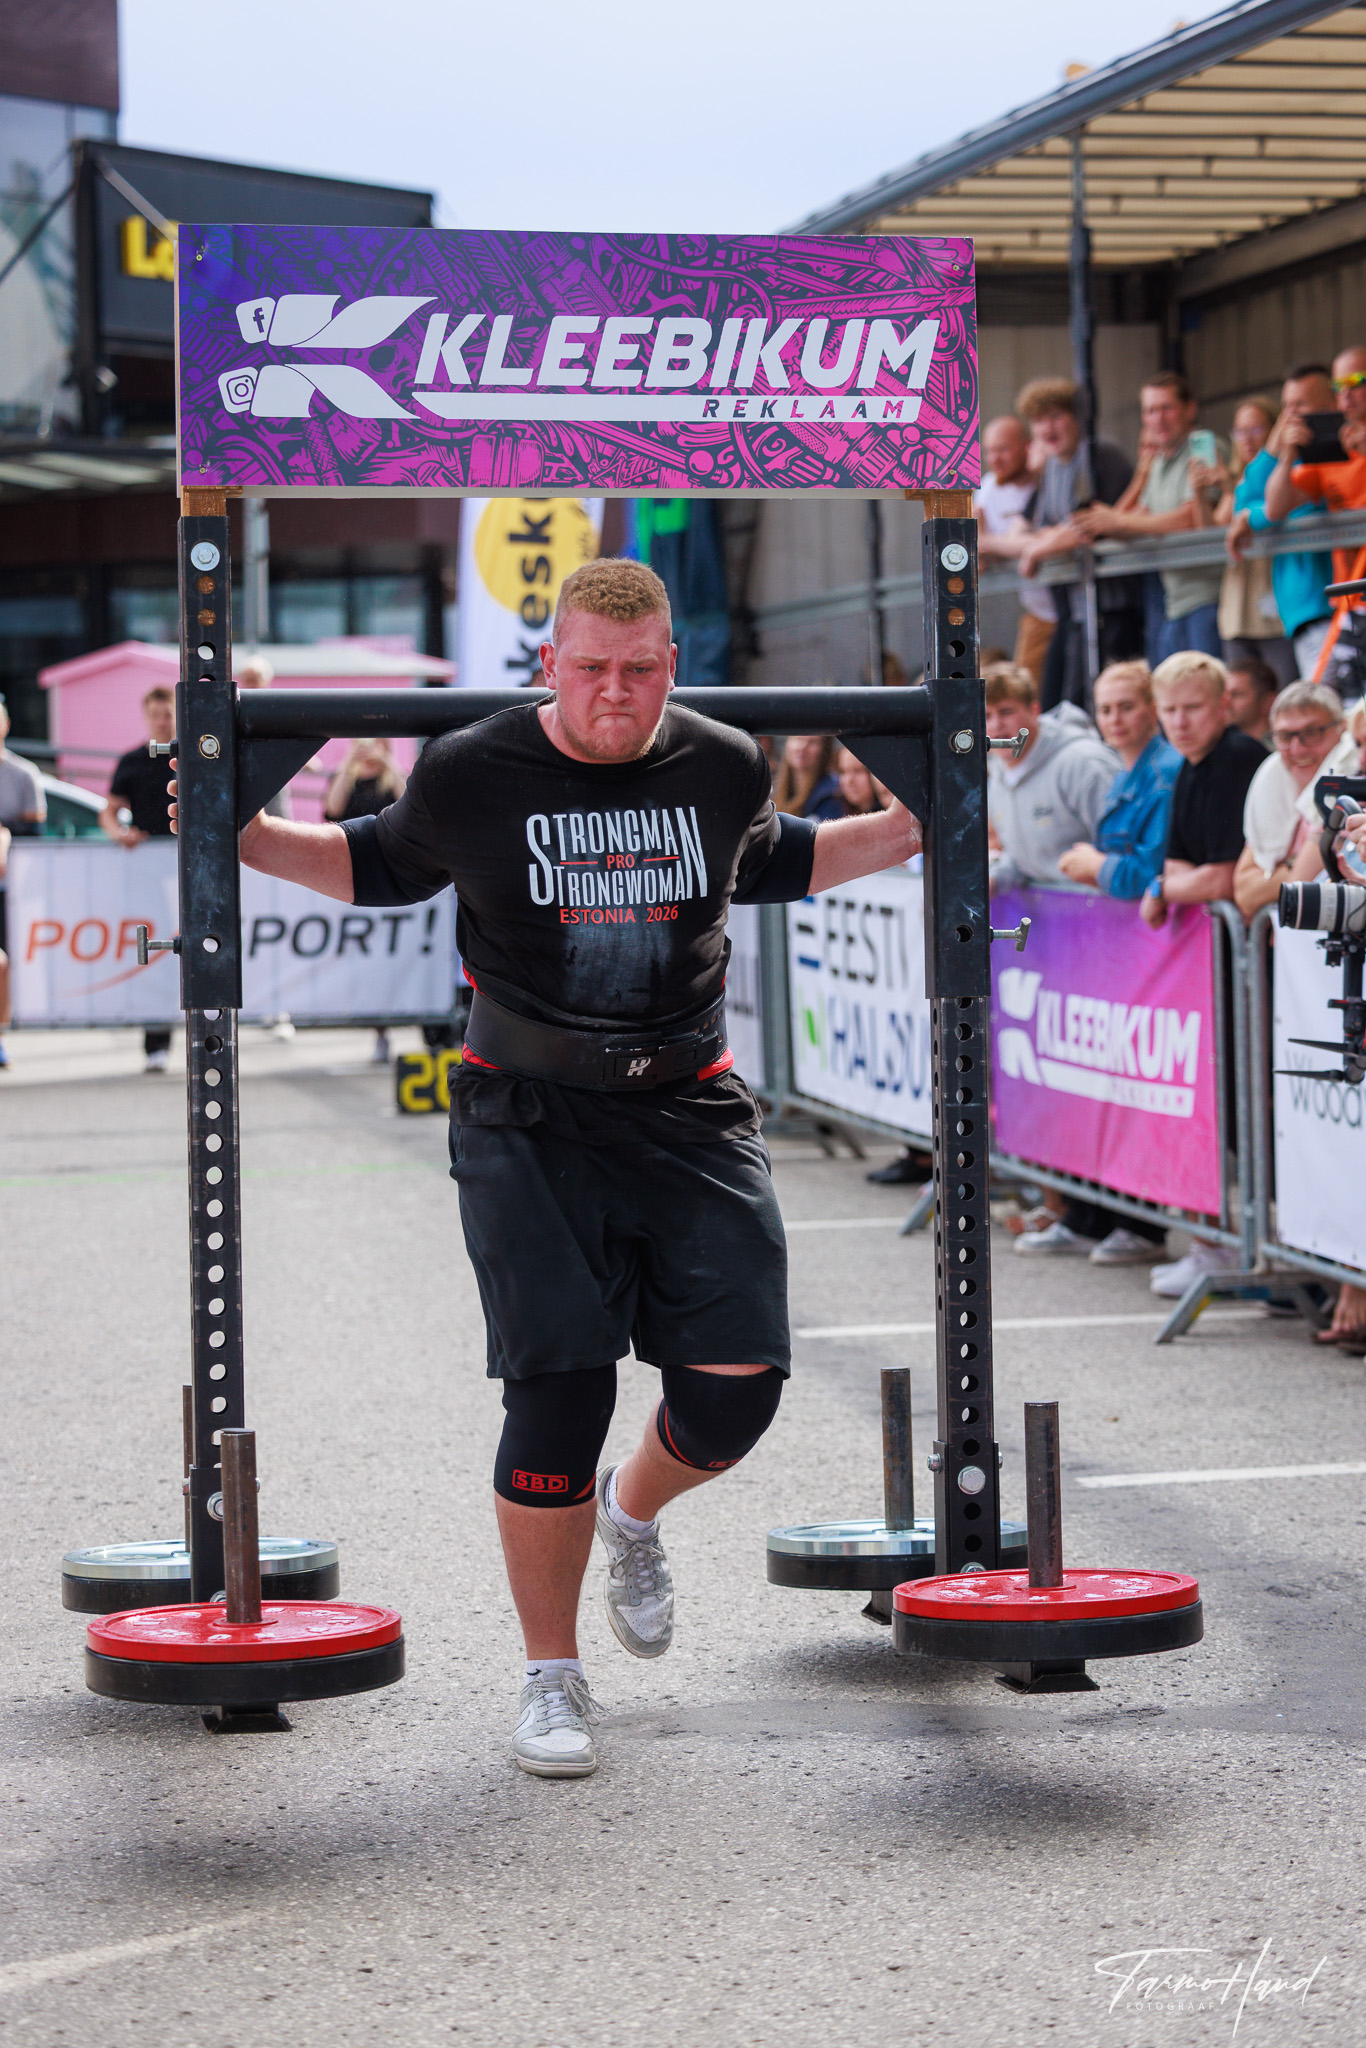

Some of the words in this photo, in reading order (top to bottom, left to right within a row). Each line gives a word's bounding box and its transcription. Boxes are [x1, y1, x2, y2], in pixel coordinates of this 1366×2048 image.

[414, 313, 940, 389] KLEEBIKUM
[702, 399, 904, 419] REKLAAM
[526, 806, 707, 875] STRONGMAN
[526, 847, 707, 906] STRONGWOMAN
[606, 854, 635, 869] PRO
[560, 908, 636, 924] ESTONIA
[646, 905, 679, 923] 2026
[248, 907, 437, 958] PORT!
[515, 1473, 564, 1490] SBD
